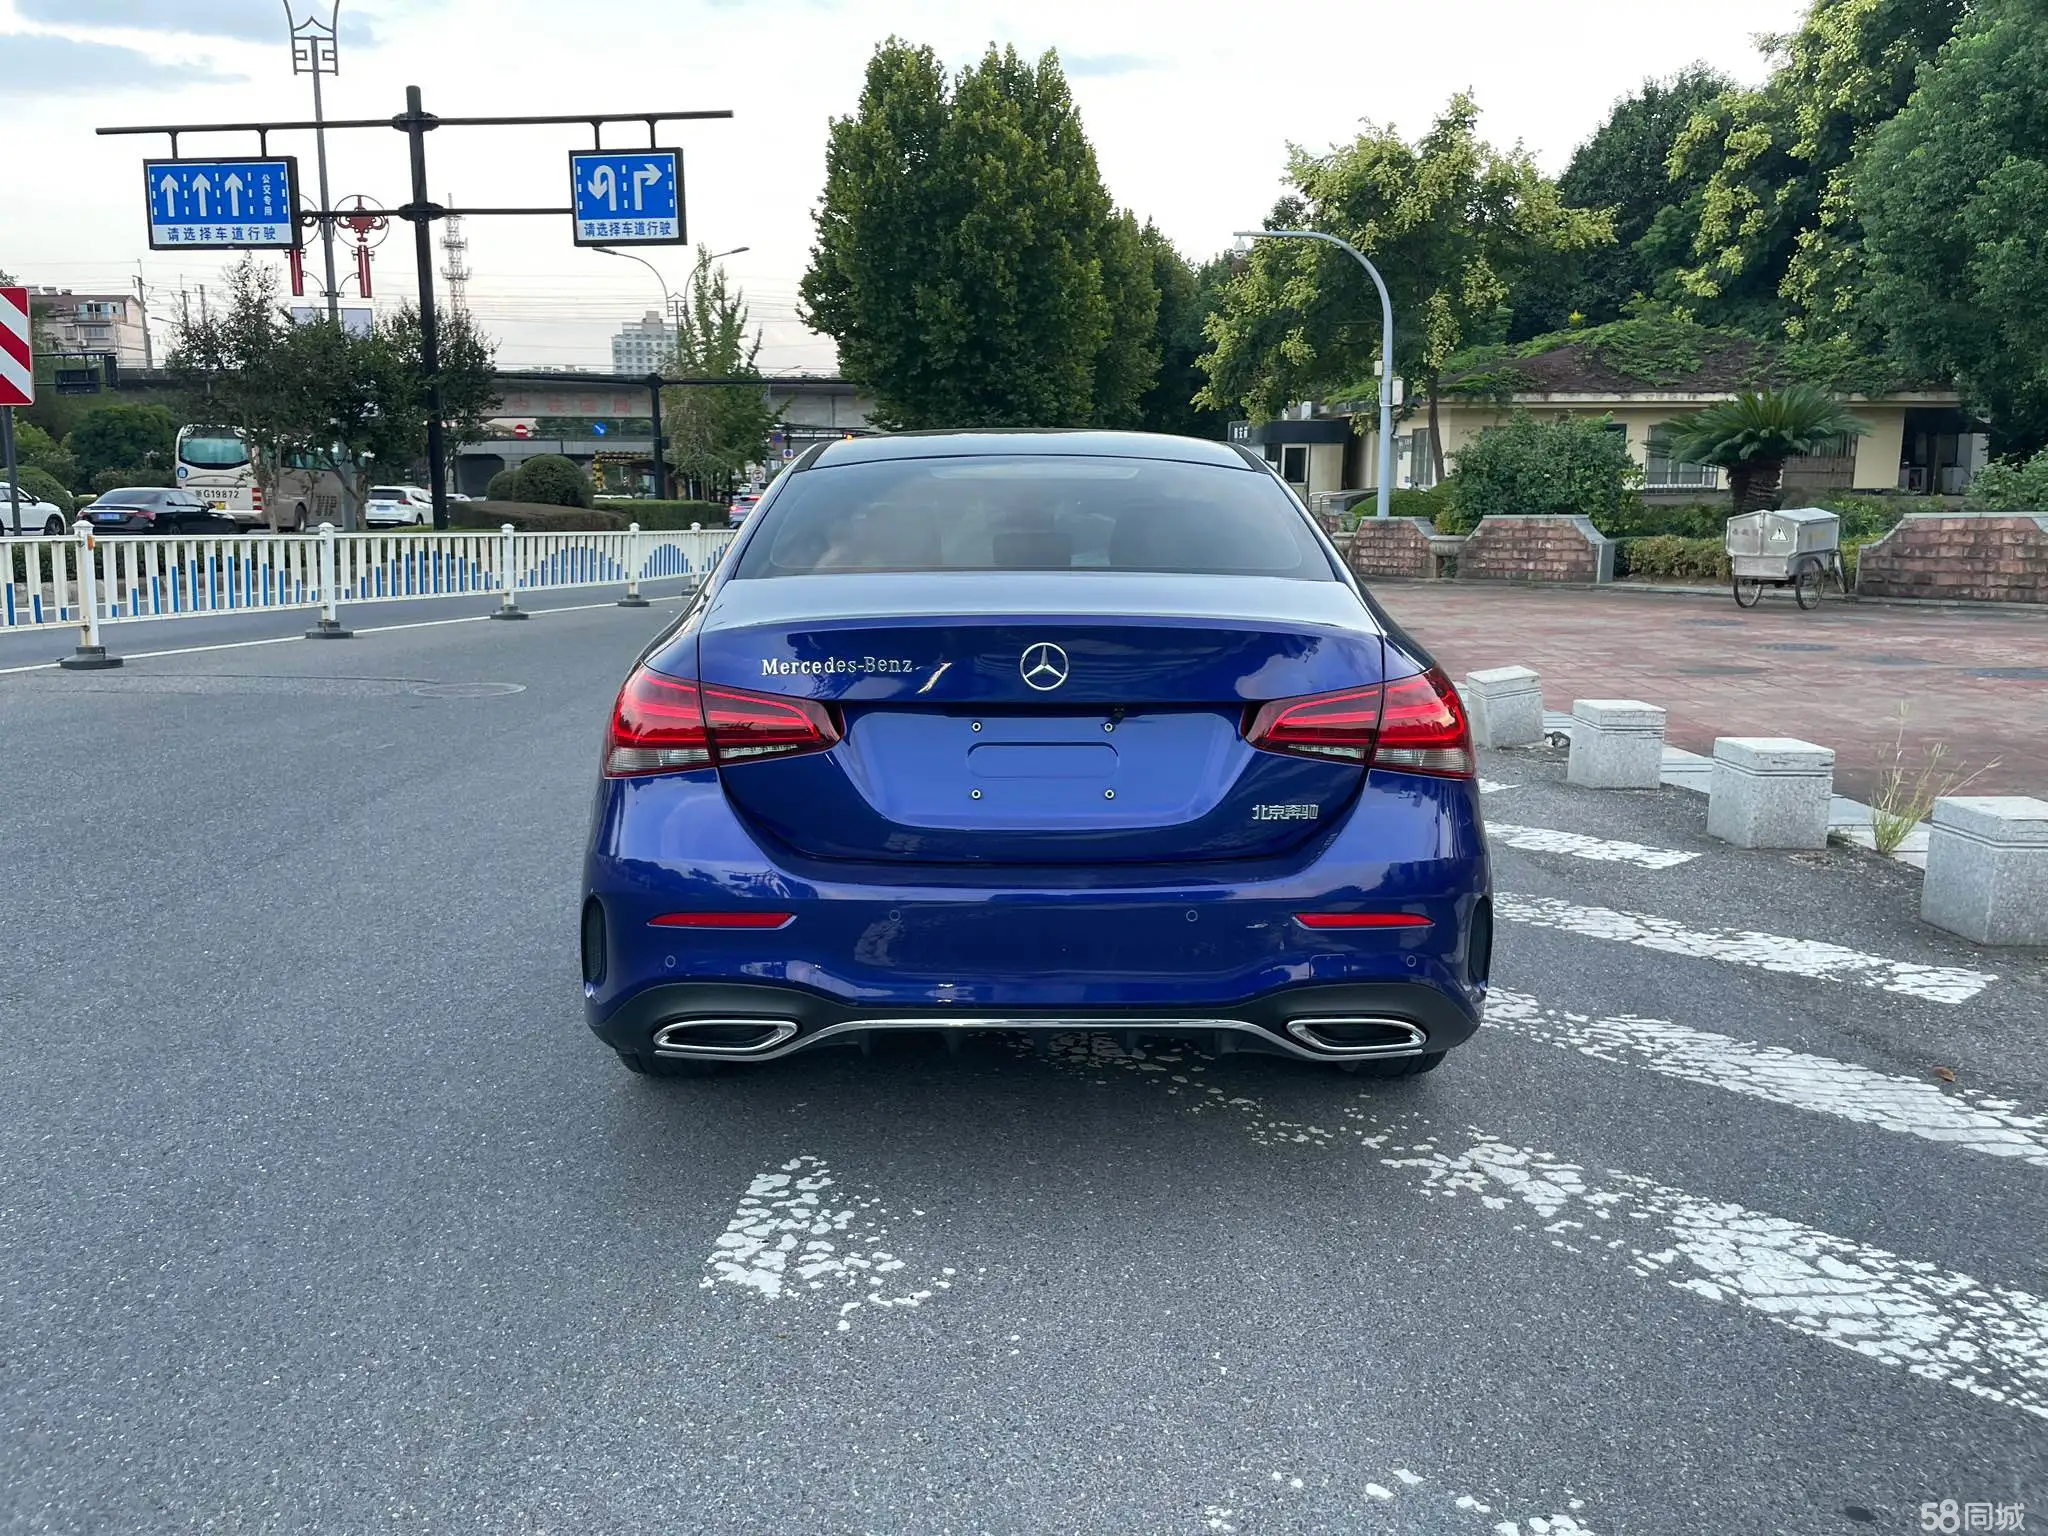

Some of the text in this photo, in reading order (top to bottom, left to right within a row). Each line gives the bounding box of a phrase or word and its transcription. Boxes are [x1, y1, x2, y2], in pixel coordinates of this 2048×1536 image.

[168, 226, 277, 242] 请选择车道行驶
[584, 221, 672, 238] 请选择车道行驶
[761, 656, 914, 677] Mercedes-Benz
[1251, 803, 1319, 820] 北京奔驰
